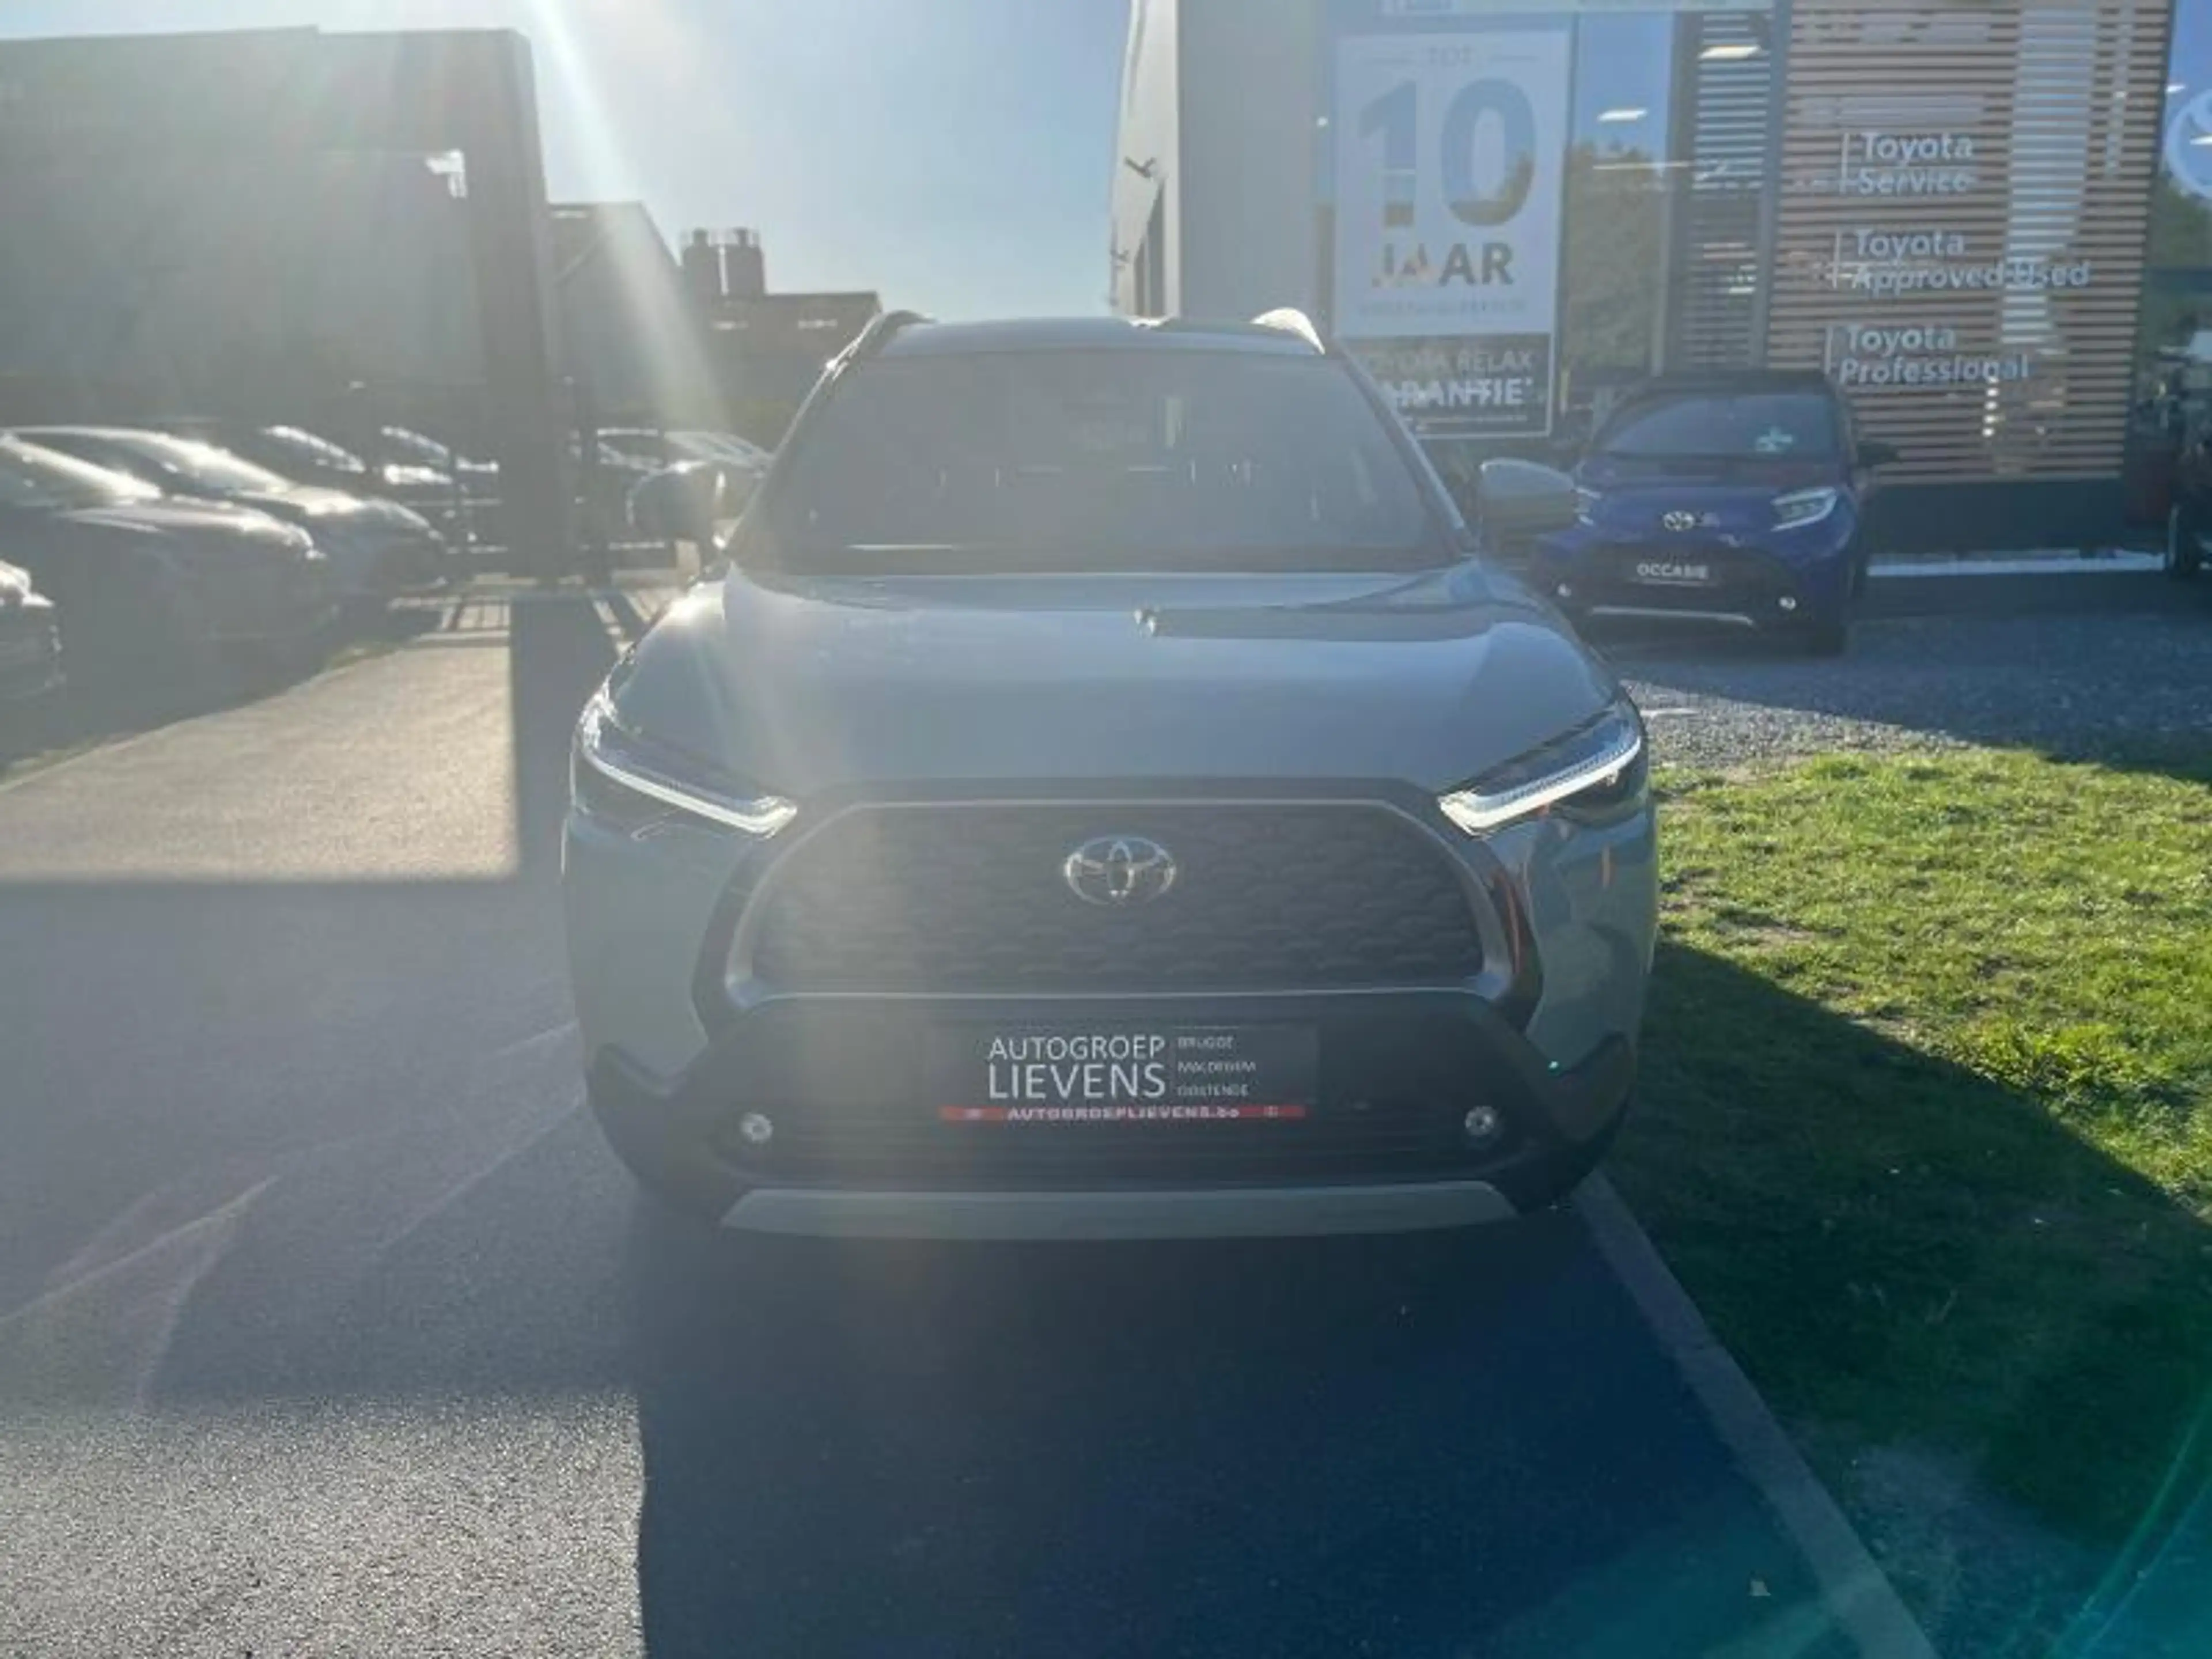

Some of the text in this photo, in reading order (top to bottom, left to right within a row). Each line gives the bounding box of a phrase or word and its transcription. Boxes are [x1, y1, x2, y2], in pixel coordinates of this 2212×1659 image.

[1357, 77, 1536, 227] 10
[1861, 131, 1974, 167] Toyota
[1857, 167, 1972, 195] Service
[1853, 228, 1965, 262] Toyota
[1371, 241, 1514, 288] JAAR
[1851, 259, 2090, 297] Approved Used
[1844, 323, 1956, 358] Toyota
[1838, 353, 2029, 385] Professional
[988, 1035, 1165, 1061] AUTOGROEP
[988, 1063, 1166, 1100] LIEVENS
